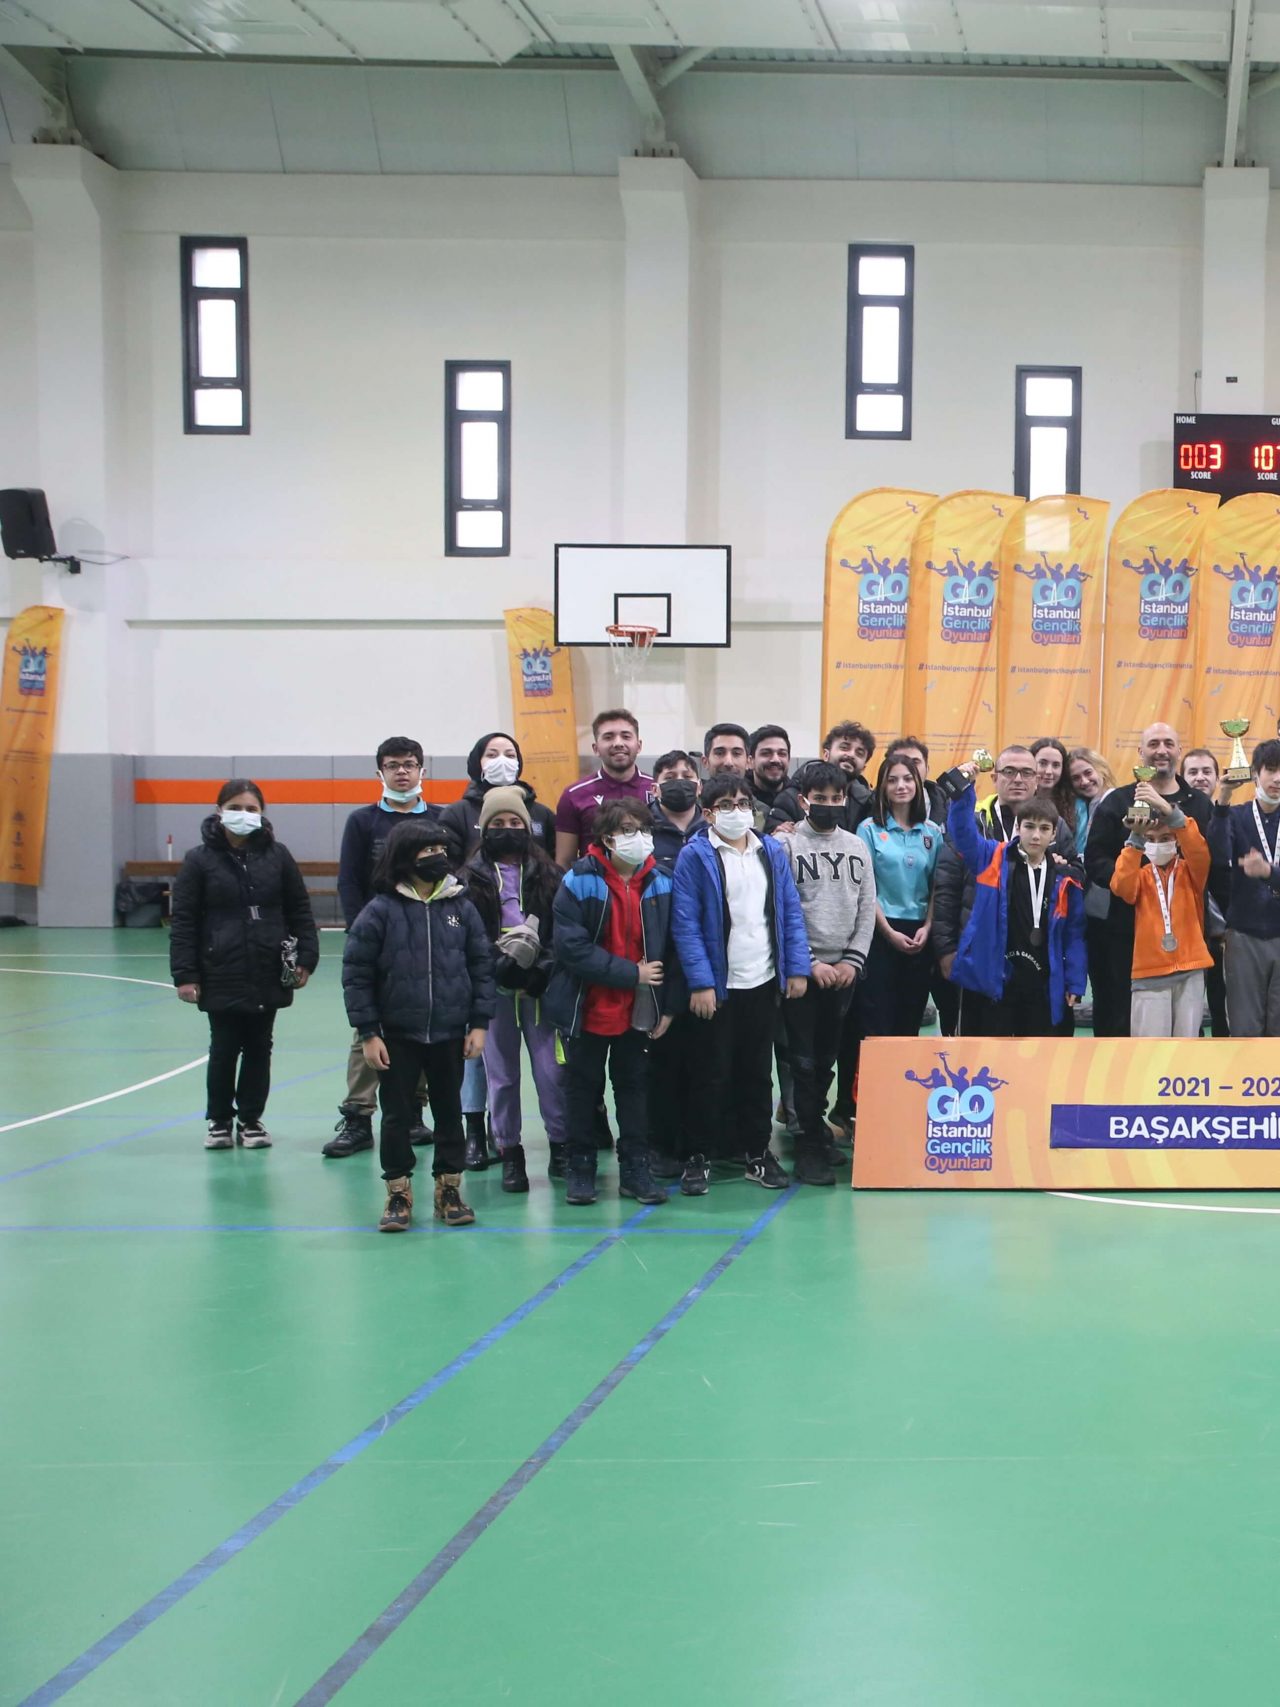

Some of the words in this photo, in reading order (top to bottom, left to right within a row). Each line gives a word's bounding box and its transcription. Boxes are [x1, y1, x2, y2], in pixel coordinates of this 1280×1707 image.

[1176, 416, 1196, 424] HOME
[1180, 444, 1221, 469] 003
[1190, 471, 1211, 479] SCORE
[1257, 472, 1278, 480] SCORE
[859, 573, 909, 602] GO
[943, 575, 995, 606] GO
[1032, 578, 1082, 608] GO
[1140, 573, 1191, 602] GO
[1230, 579, 1279, 610] GO
[860, 600, 908, 614] İstanbul
[943, 602, 992, 617] İstanbul
[1033, 604, 1080, 619] İstanbul
[1141, 600, 1188, 614] İstanbul
[1230, 606, 1276, 622] İstanbul
[859, 614, 907, 629] Gençlik
[943, 617, 991, 632] Gençlik
[1033, 619, 1081, 634] Gençlik
[1140, 614, 1188, 629] Gençlik
[1229, 621, 1275, 636] Gençlik
[796, 852, 864, 885] NYC
[1158, 1077, 1210, 1097] 2021
[928, 1085, 995, 1123] GO
[928, 1120, 992, 1138] İstanbul
[927, 1139, 991, 1157] Gençlik
[925, 1155, 992, 1173] Oyunları
